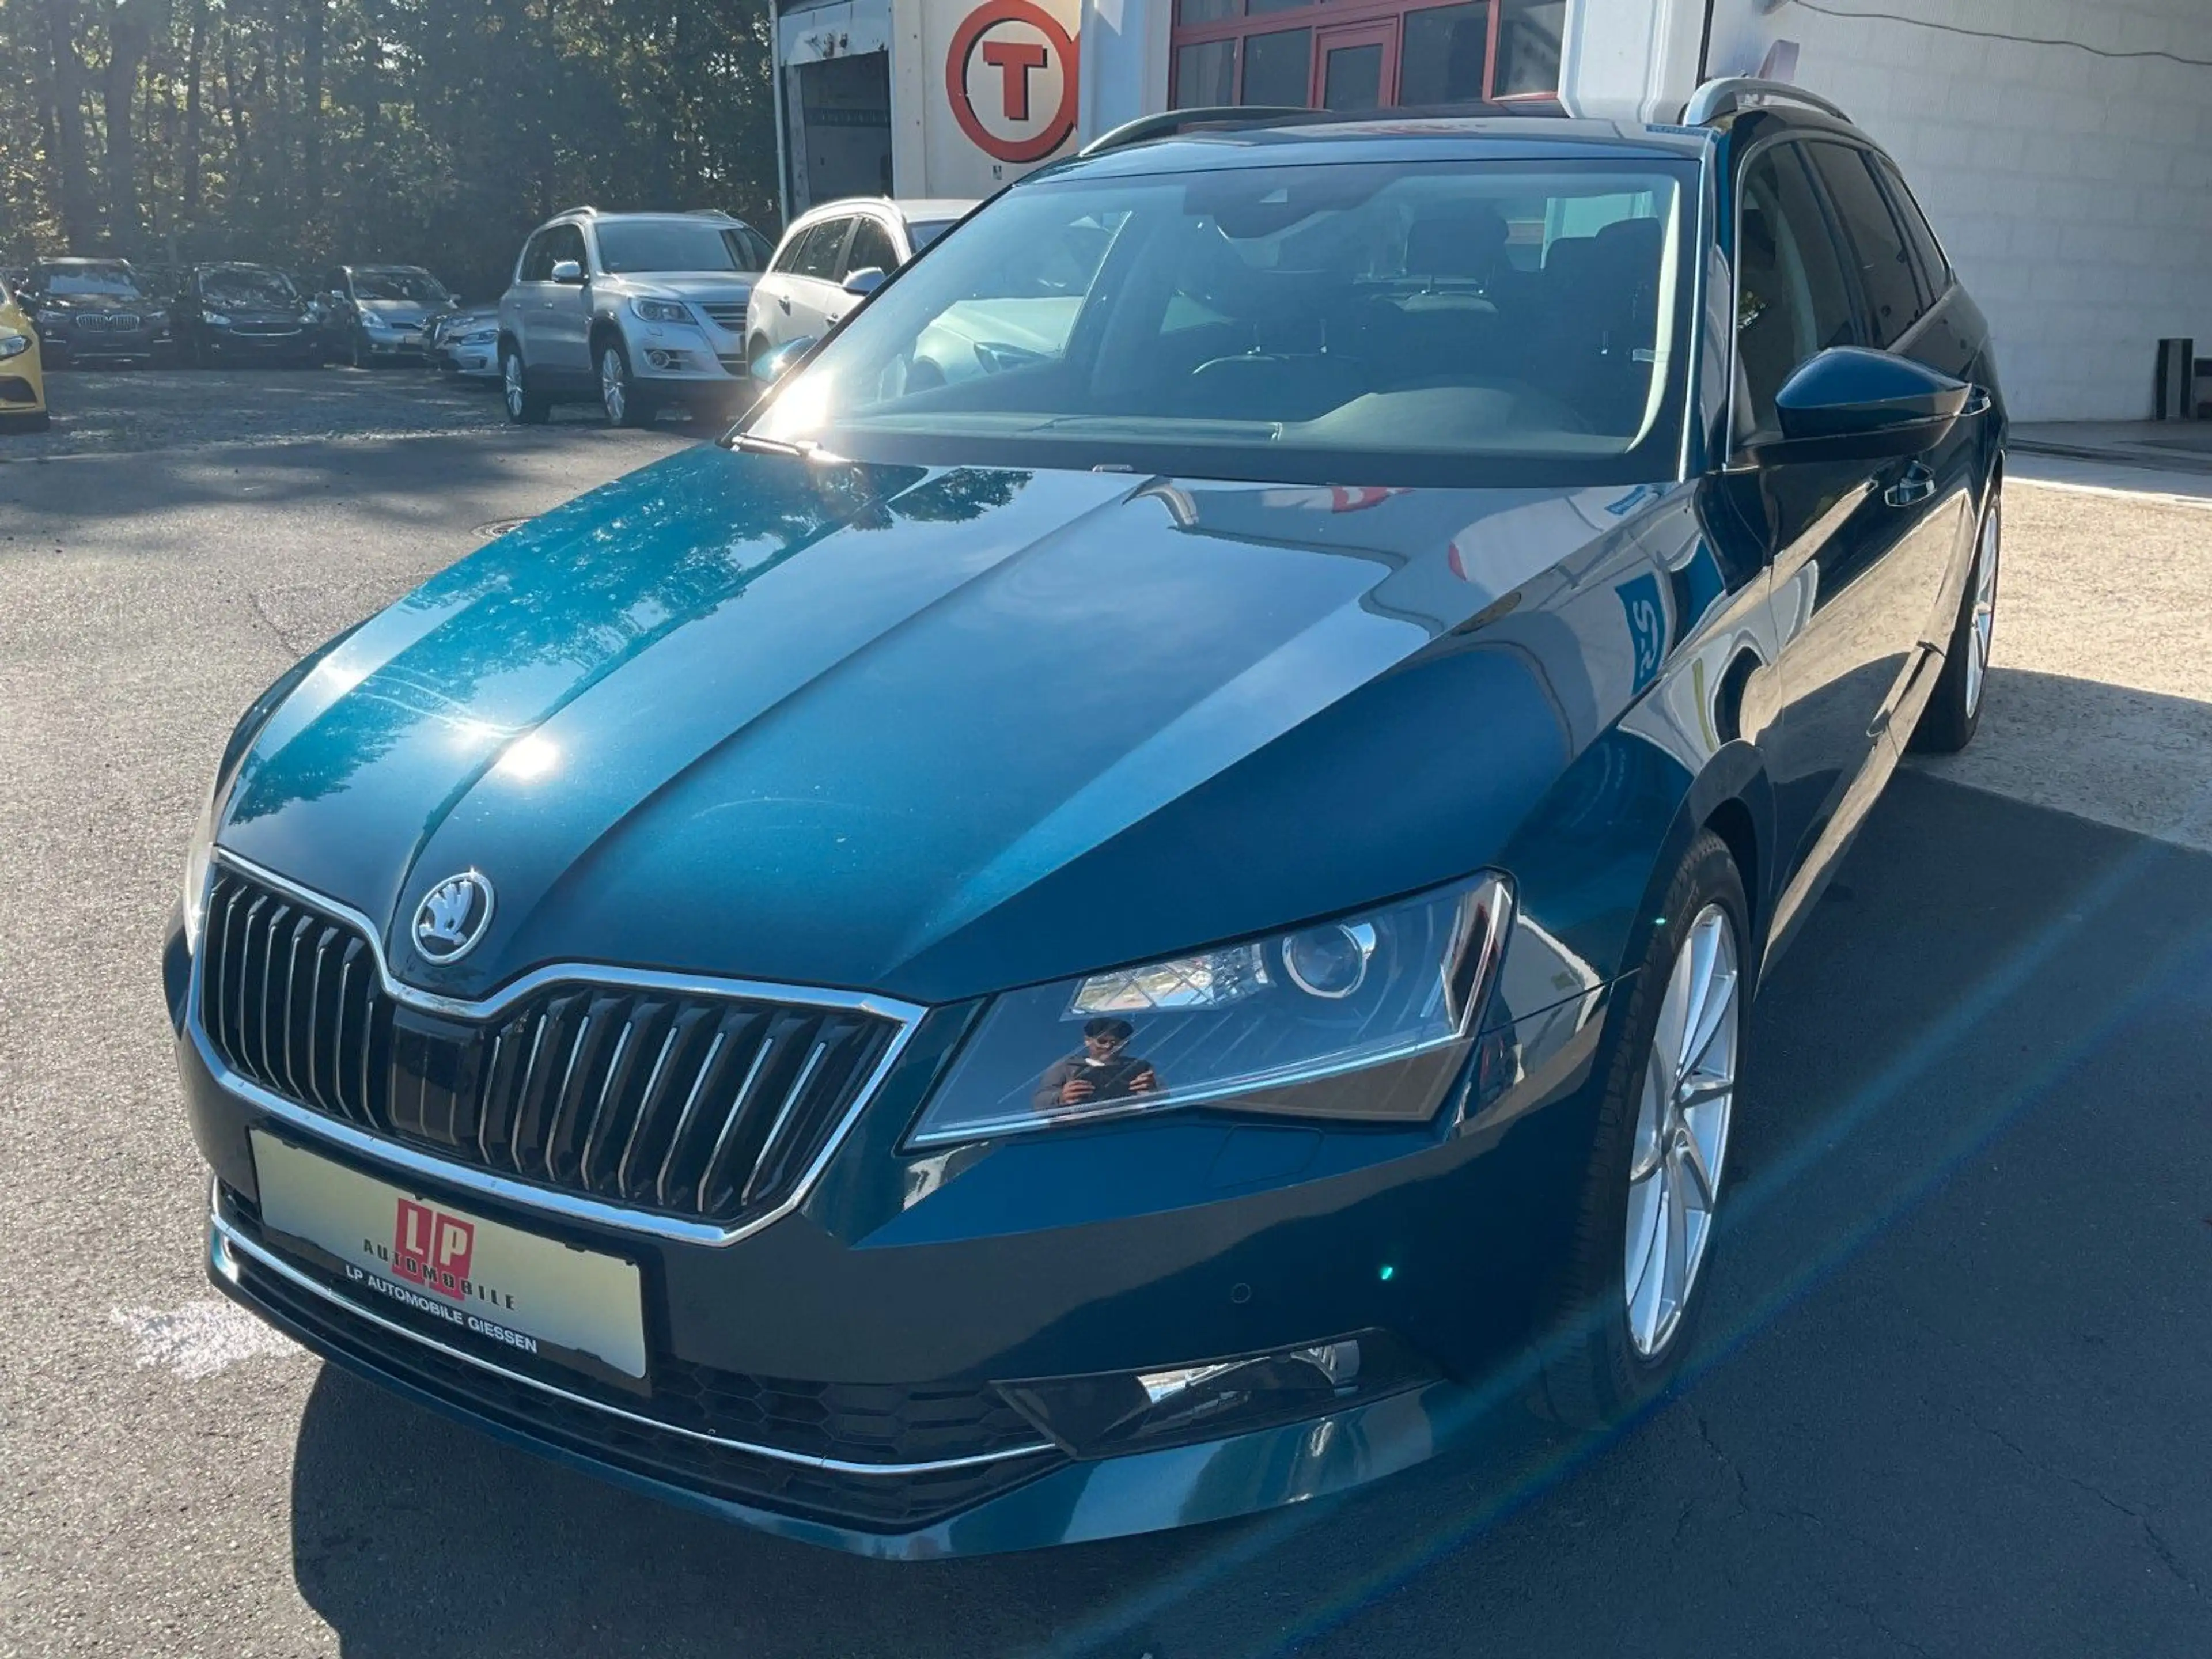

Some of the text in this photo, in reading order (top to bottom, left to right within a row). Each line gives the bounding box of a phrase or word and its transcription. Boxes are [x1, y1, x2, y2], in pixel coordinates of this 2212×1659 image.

[983, 41, 1047, 122] T
[363, 1237, 515, 1310] AUTOMOBILE
[405, 1208, 468, 1266] LP
[346, 1265, 537, 1354] LP AUTOMOBILE GIESSEN
